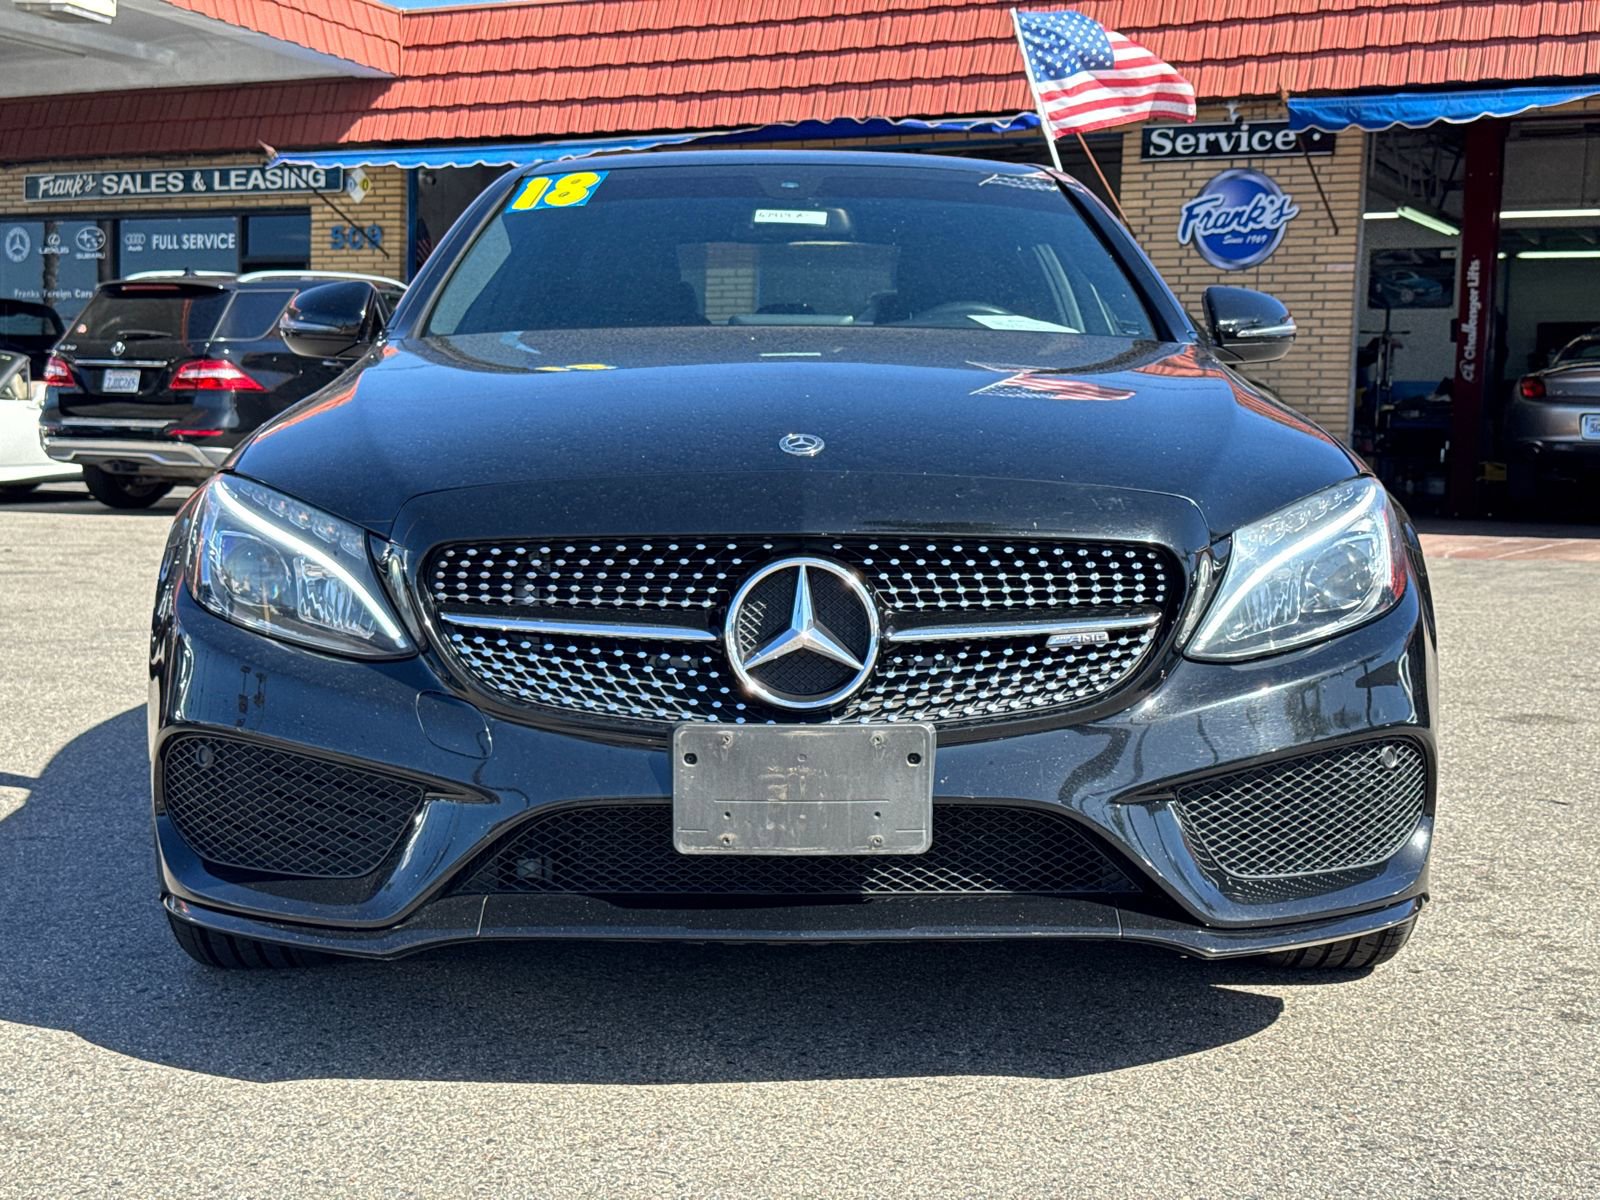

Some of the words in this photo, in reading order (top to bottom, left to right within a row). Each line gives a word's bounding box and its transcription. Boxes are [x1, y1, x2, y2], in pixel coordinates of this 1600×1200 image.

[1150, 125, 1297, 156] Service
[38, 174, 97, 199] Frank's
[102, 172, 184, 195] SALES
[192, 171, 207, 191] &
[213, 169, 326, 190] LEASING
[512, 172, 600, 210] 18
[1178, 193, 1299, 245] Frank's
[152, 234, 179, 250] FULL
[182, 233, 236, 250] SERVICE
[329, 224, 383, 250] 509
[1222, 234, 1244, 244] Since
[1466, 259, 1480, 287] Lifts
[1461, 288, 1482, 360] Challenger
